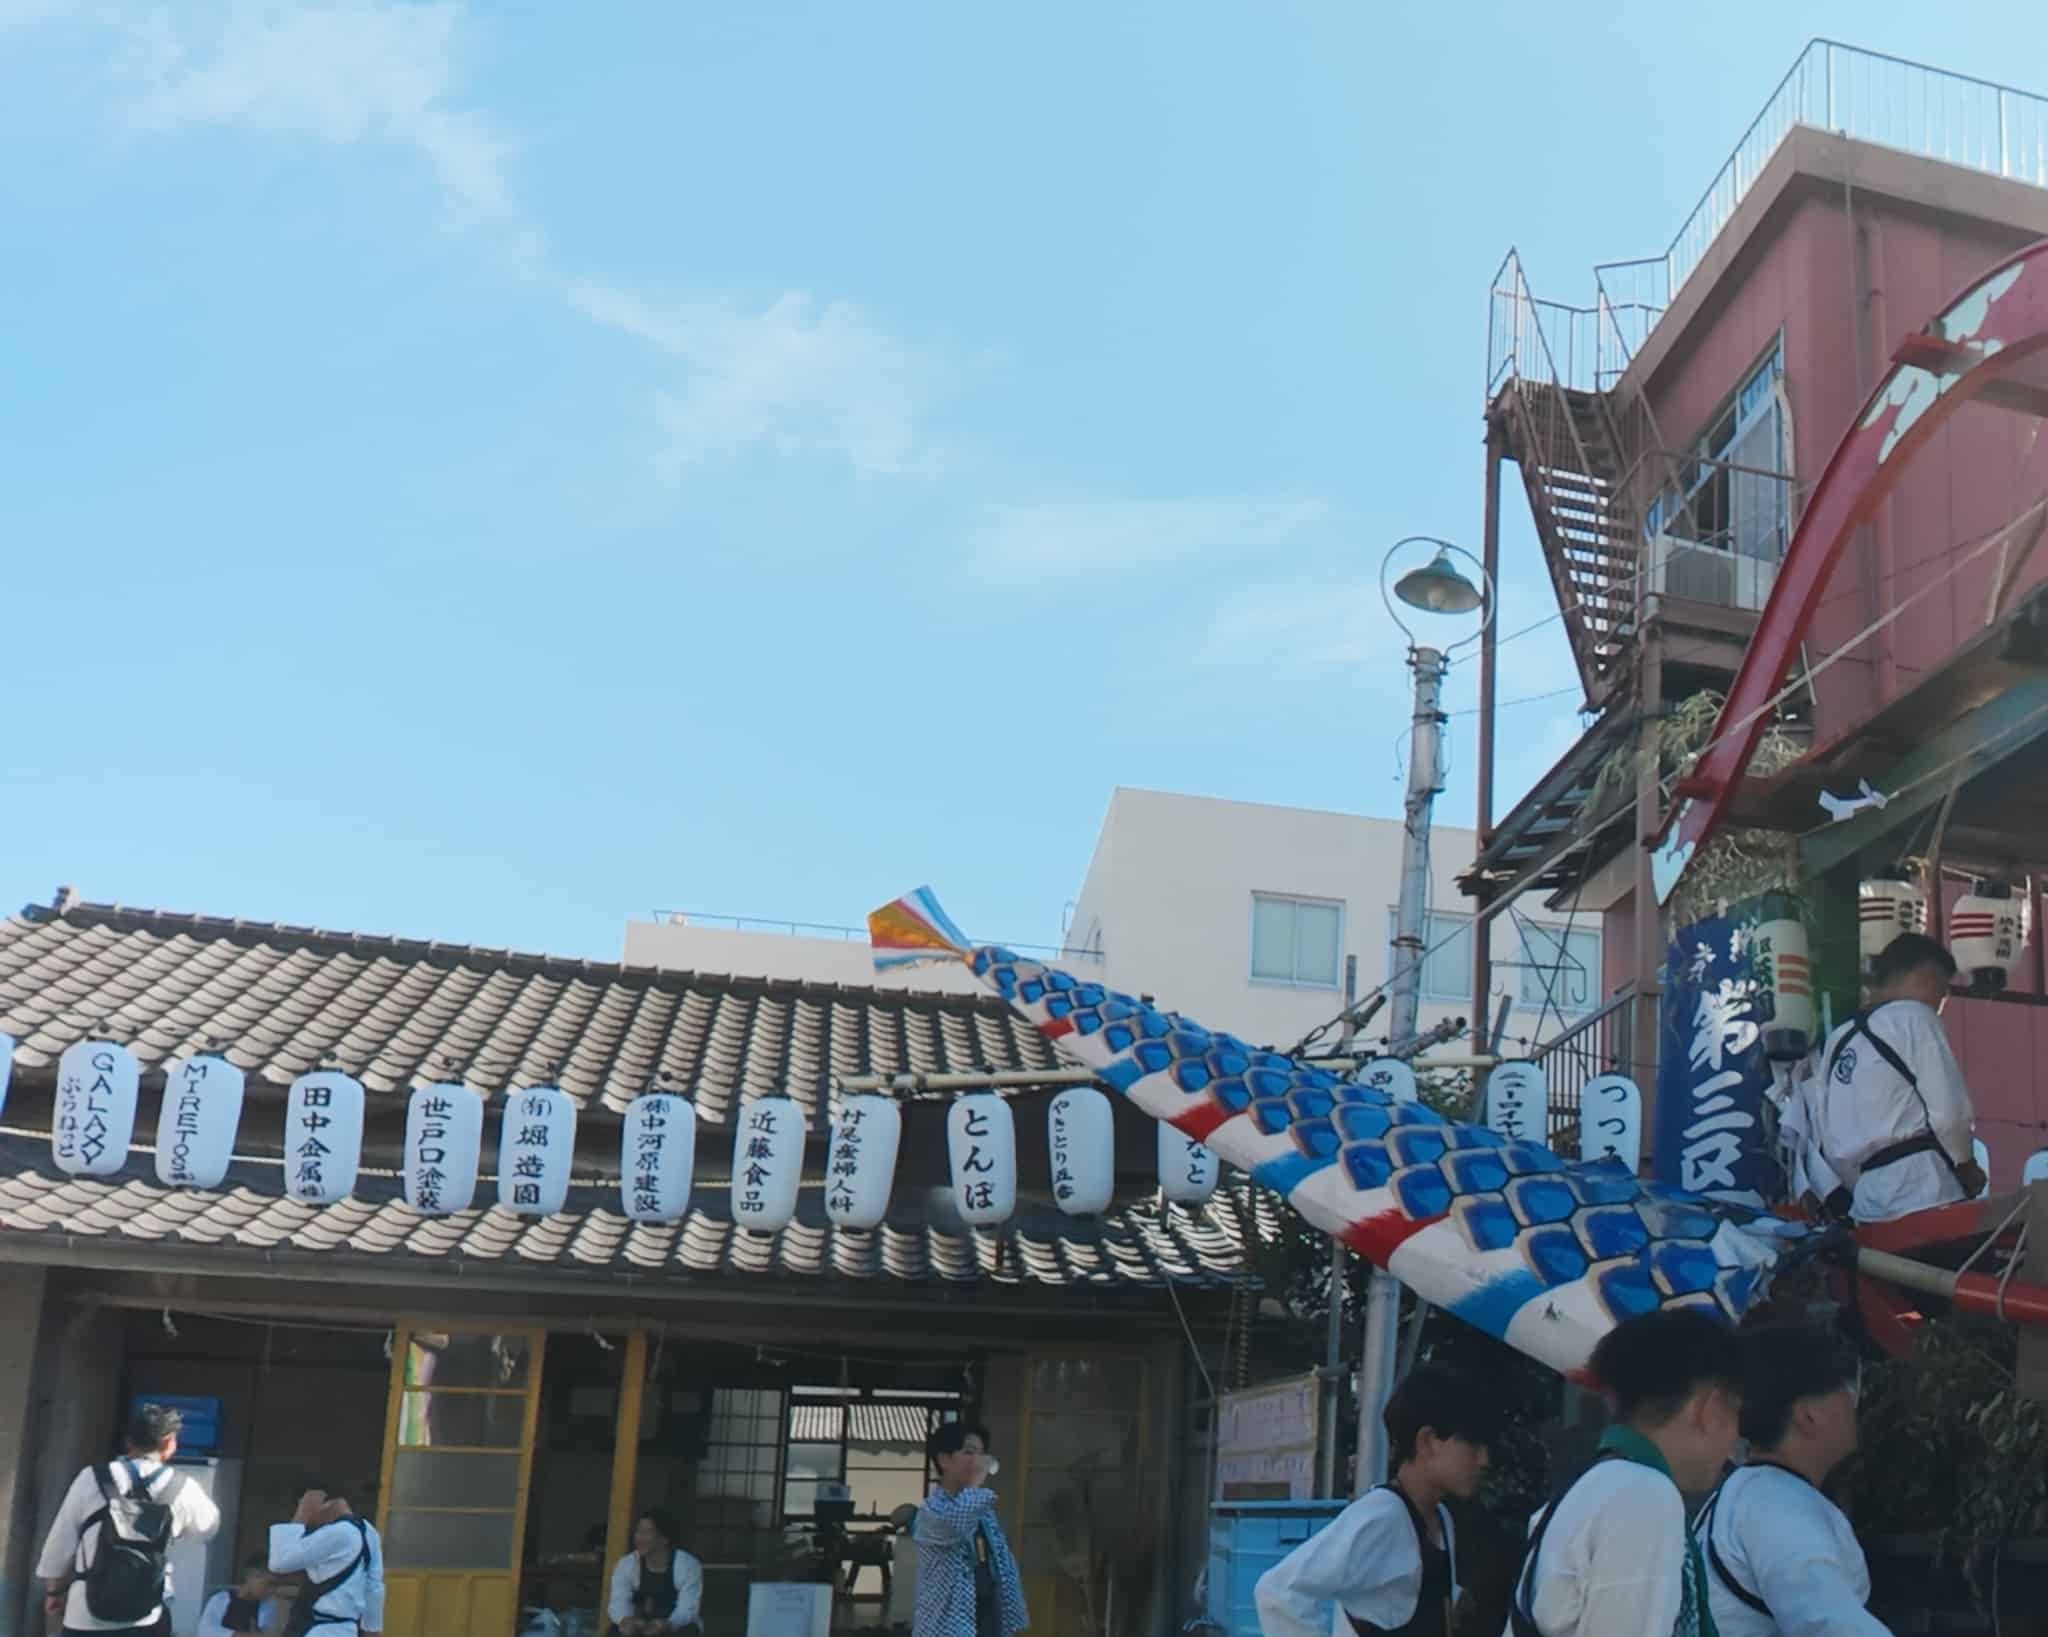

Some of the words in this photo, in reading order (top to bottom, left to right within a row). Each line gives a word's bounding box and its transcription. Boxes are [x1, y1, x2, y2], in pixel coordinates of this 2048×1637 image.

[80, 1052, 115, 1166] GALAXY
[1680, 977, 1763, 1206] 第三区
[740, 1111, 778, 1213] 近藤食品
[962, 1109, 994, 1210] とんぼ
